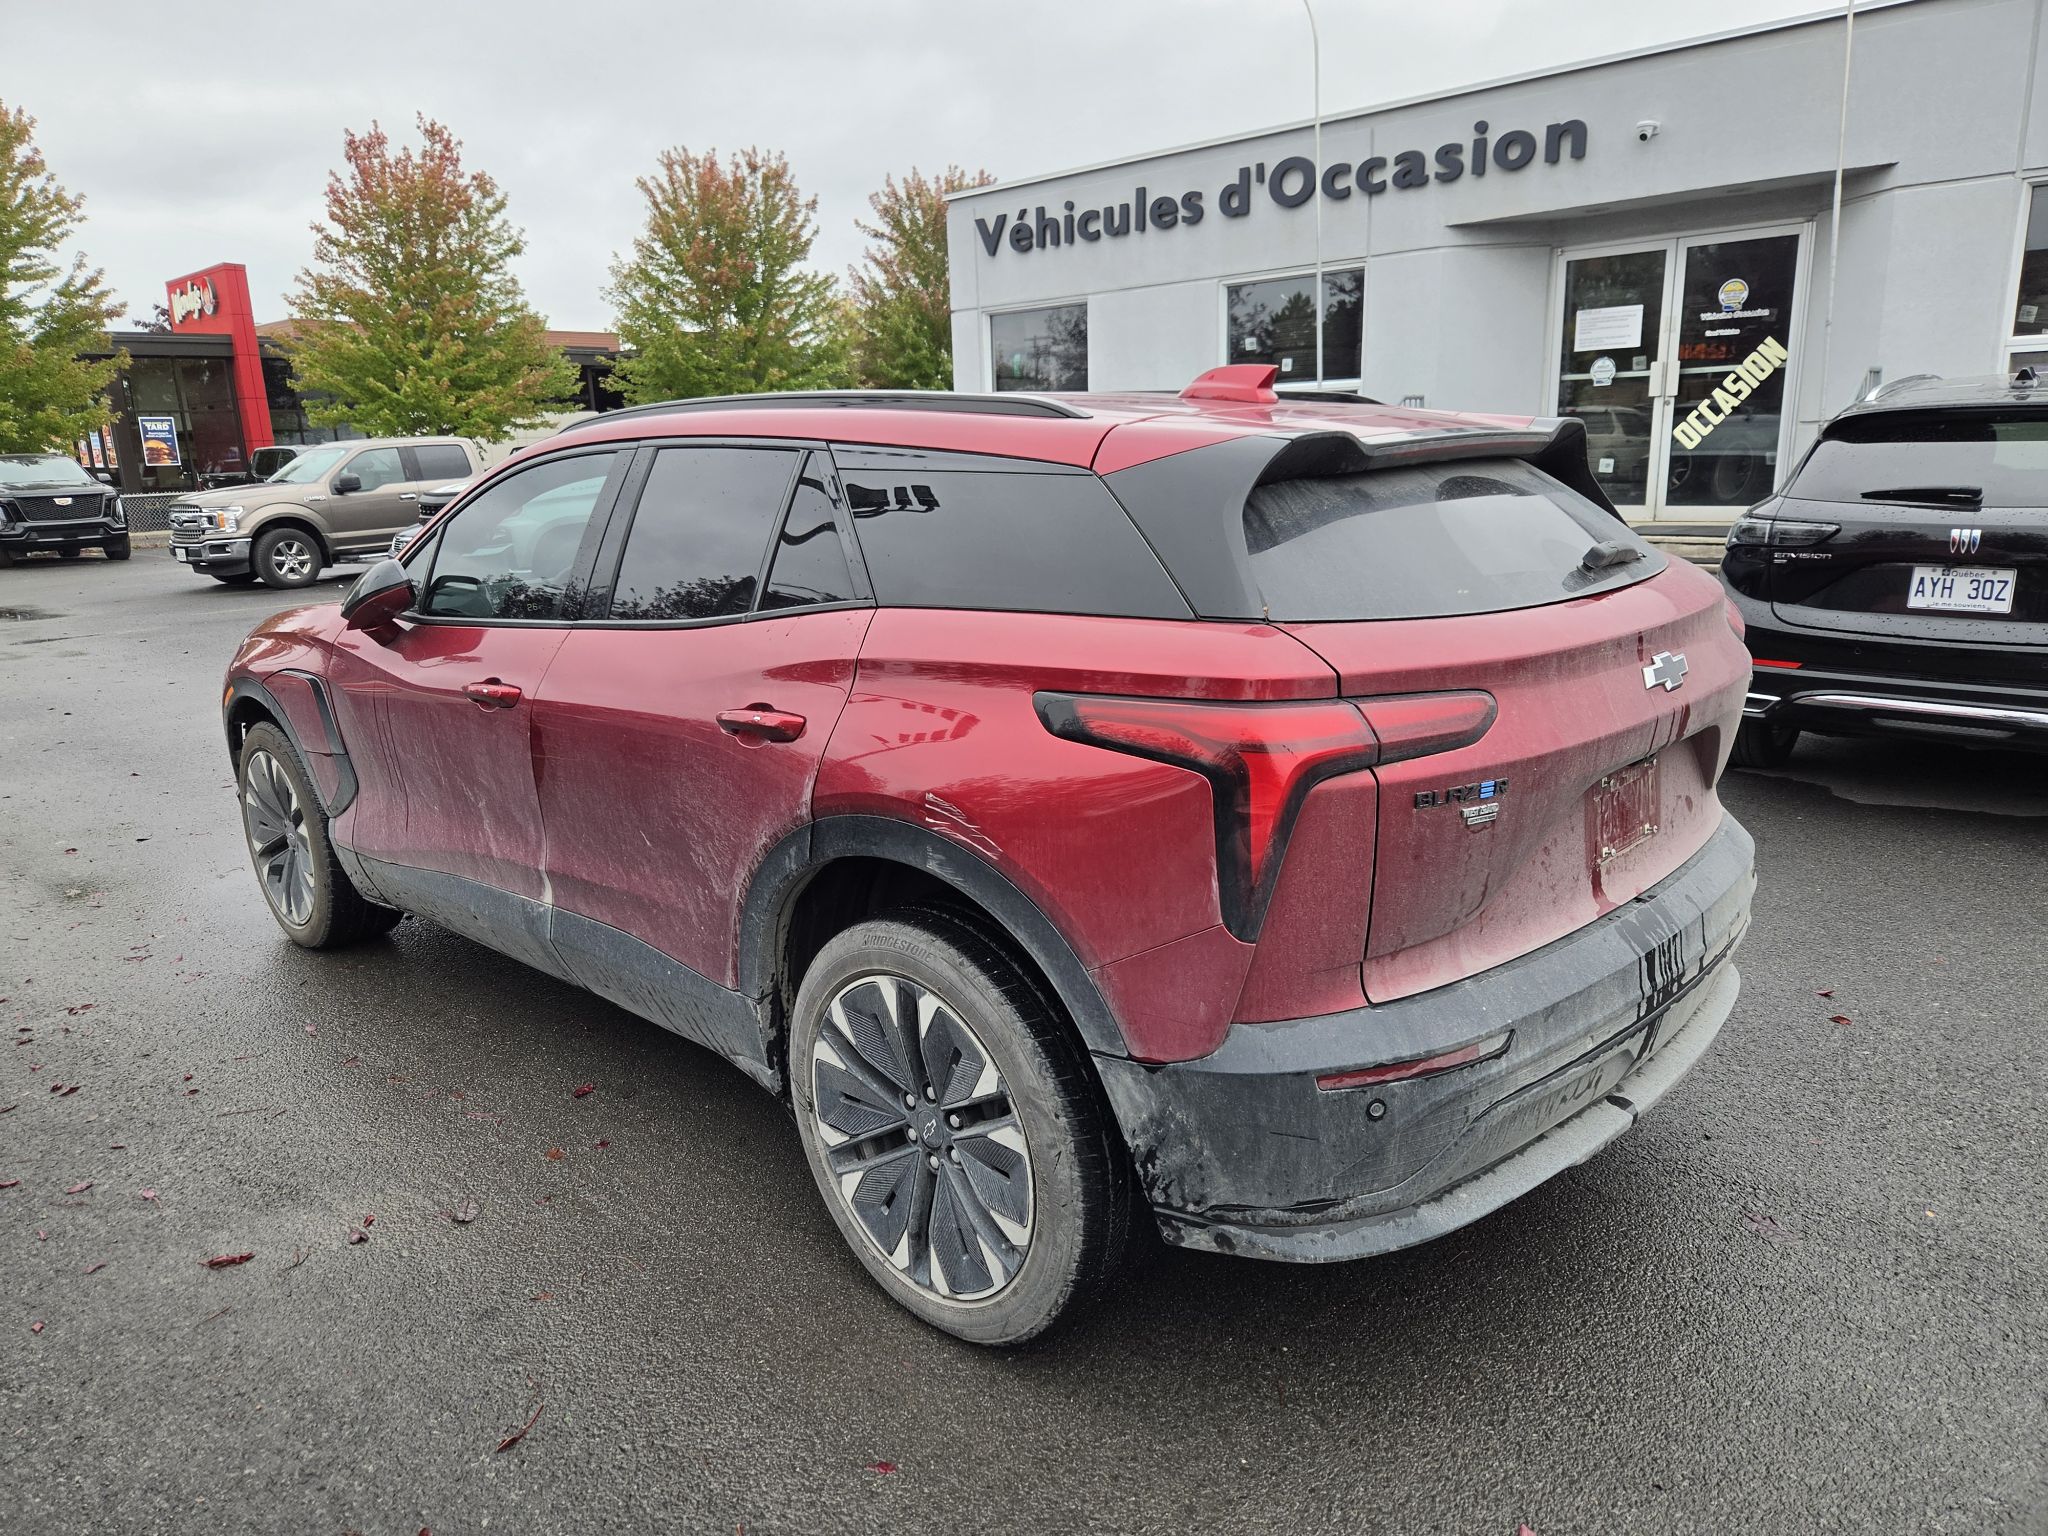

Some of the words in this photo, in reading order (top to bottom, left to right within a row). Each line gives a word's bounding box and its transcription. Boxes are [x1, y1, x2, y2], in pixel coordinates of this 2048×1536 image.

[975, 186, 1204, 257] Véhicules
[1218, 120, 1588, 217] d'Occasion
[1672, 336, 1788, 450] OCCASION
[1914, 576, 1954, 598] AYH
[1968, 579, 2009, 601] 30Z
[1951, 570, 1985, 578] Québec
[1414, 778, 1508, 809] BLAZER
[861, 934, 934, 962] BRIDGESTONE
